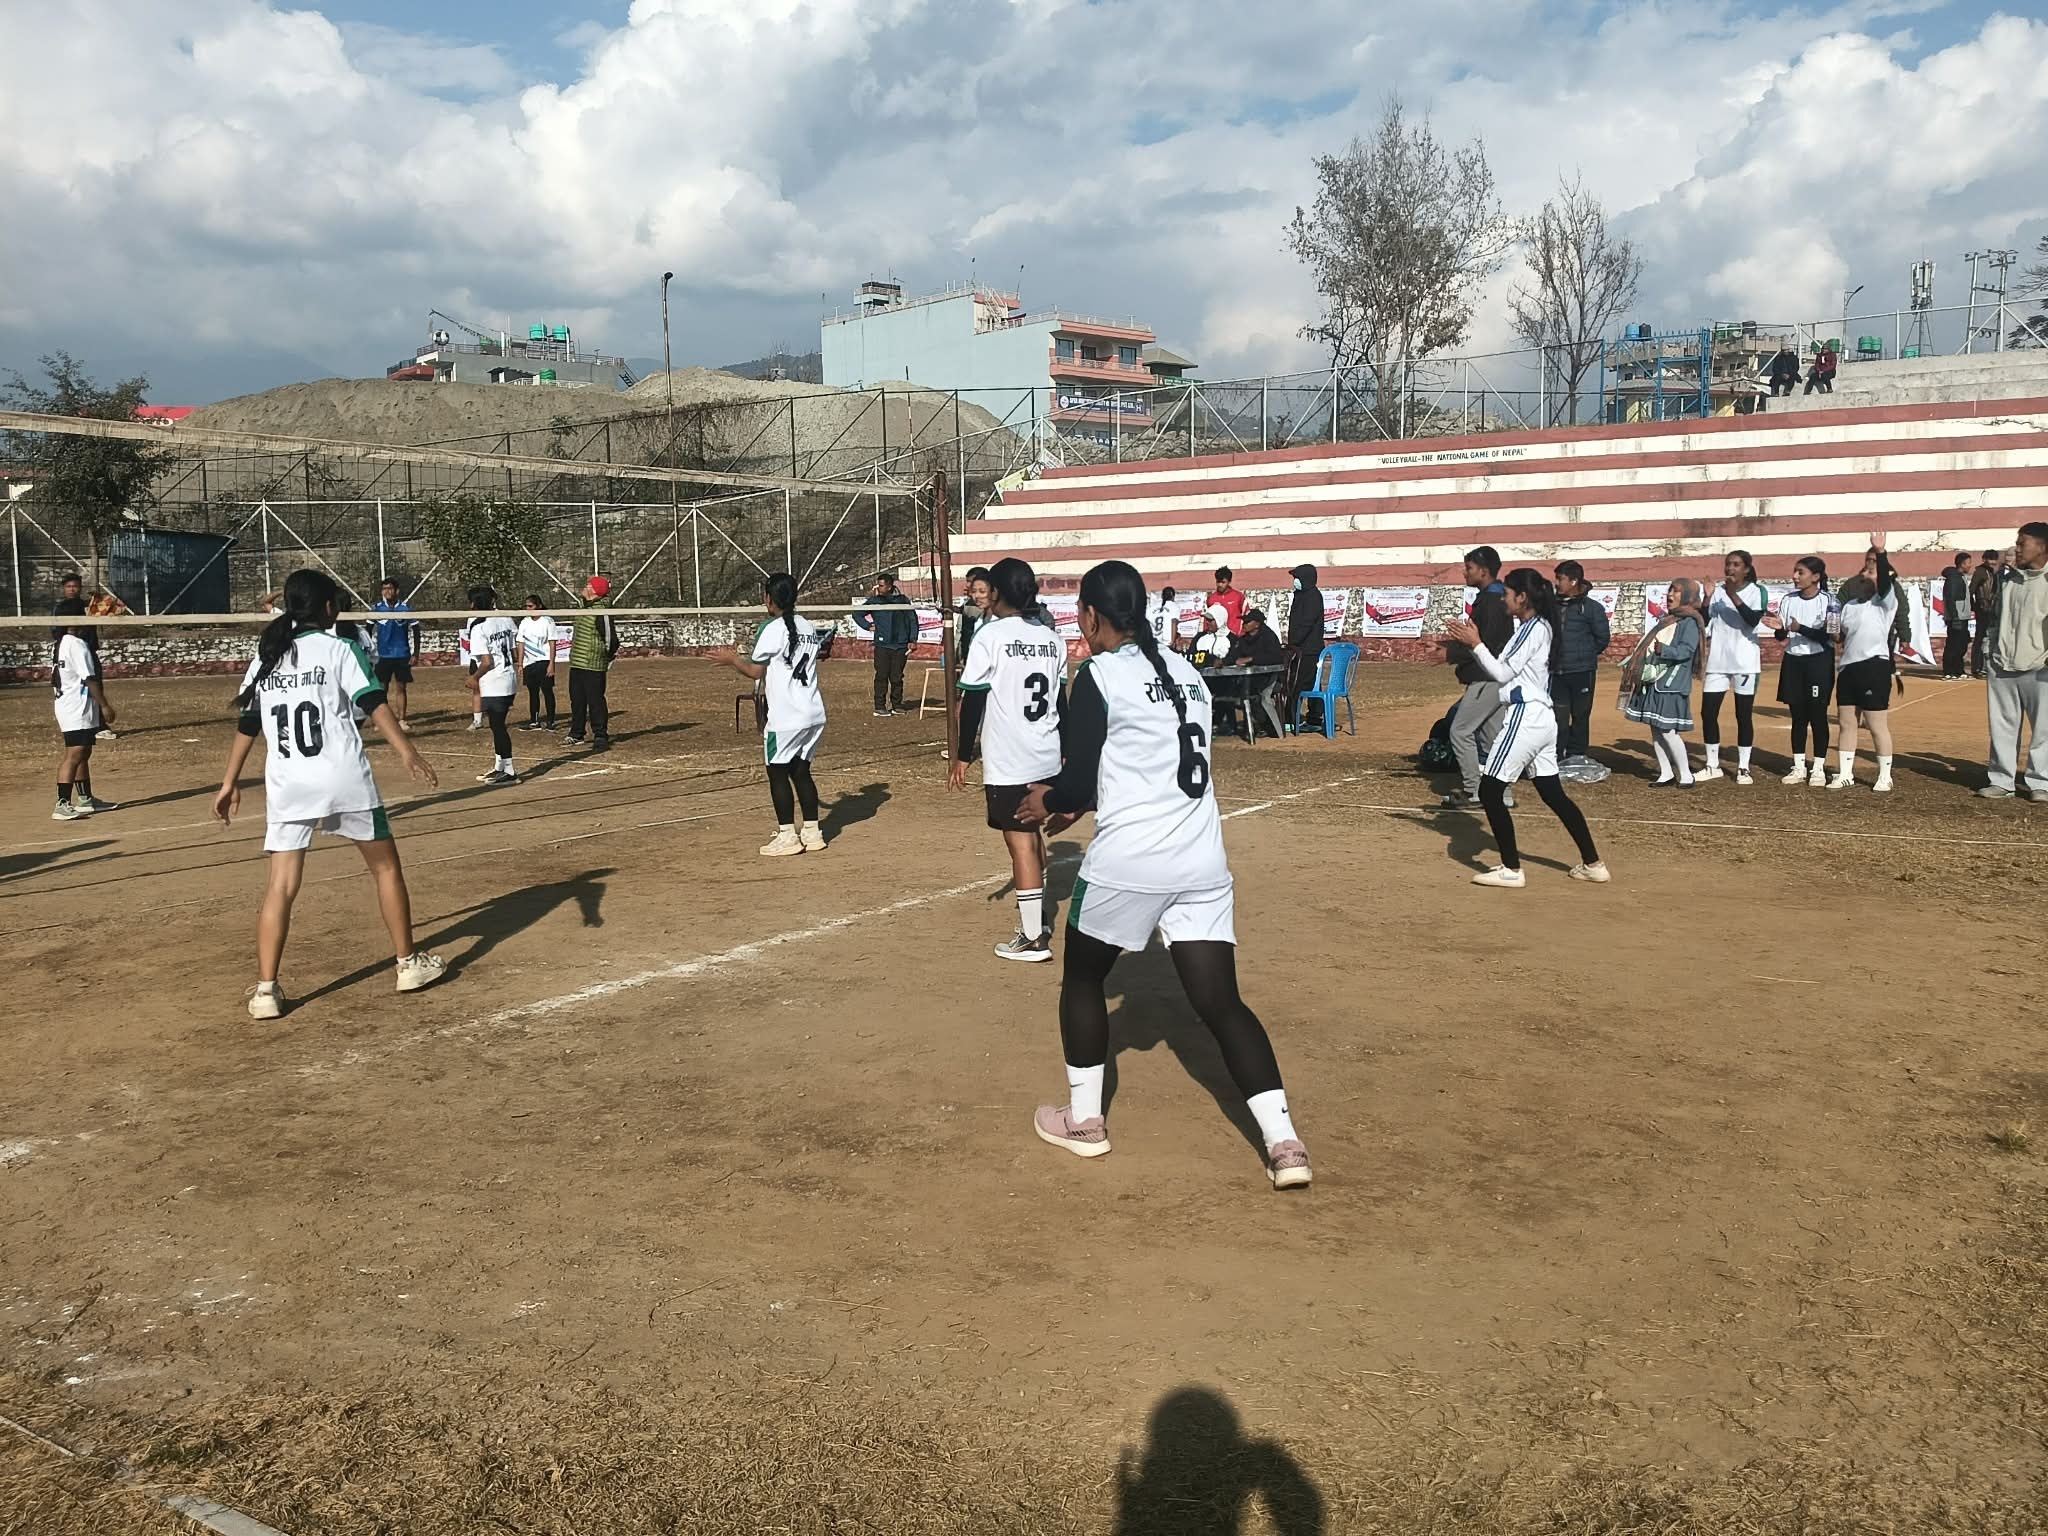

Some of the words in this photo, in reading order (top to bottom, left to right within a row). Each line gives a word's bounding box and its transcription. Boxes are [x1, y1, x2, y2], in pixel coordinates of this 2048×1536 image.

[1437, 452, 1469, 461] NATIONAL
[1470, 450, 1489, 459] GAME
[1155, 616, 1163, 631] 8
[792, 652, 809, 687] 4
[1194, 652, 1206, 664] 13
[1741, 674, 1750, 687] 7
[1023, 672, 1049, 722] 3
[270, 700, 324, 759] 10
[1176, 722, 1209, 799] 6
